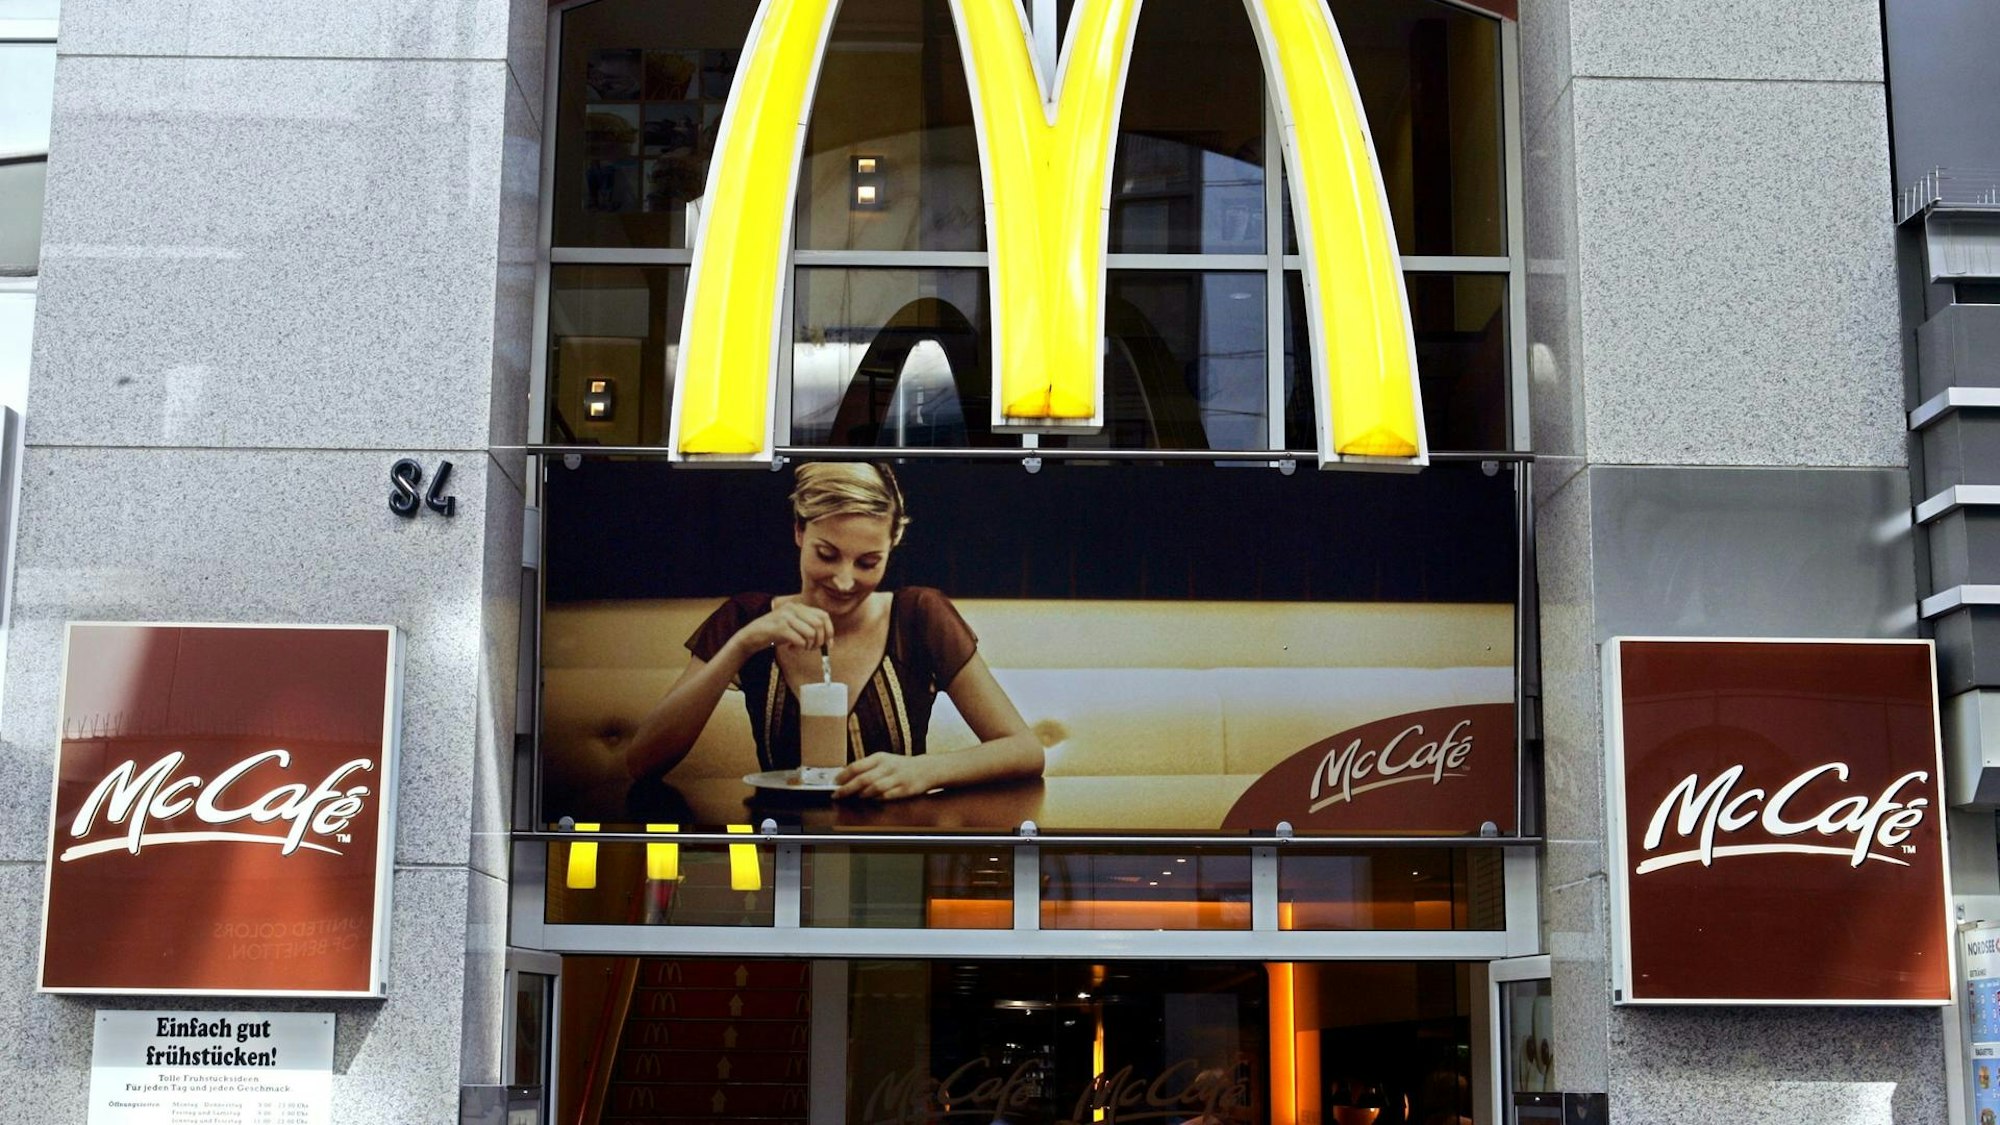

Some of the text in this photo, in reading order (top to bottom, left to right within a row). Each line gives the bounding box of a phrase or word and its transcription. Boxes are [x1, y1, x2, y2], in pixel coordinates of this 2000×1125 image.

[389, 458, 456, 518] 84
[1310, 719, 1473, 802] McCafé
[70, 749, 373, 856] McCafé
[1643, 762, 1928, 868] McCafé
[1967, 940, 1995, 956] NORDSEE
[156, 1017, 271, 1042] Einfach gut
[146, 1045, 277, 1067] frühstücken!
[143, 1084, 169, 1093] jeden
[170, 1084, 187, 1093] Tag
[209, 1085, 235, 1094] jeden
[158, 1074, 181, 1083] Tolle
